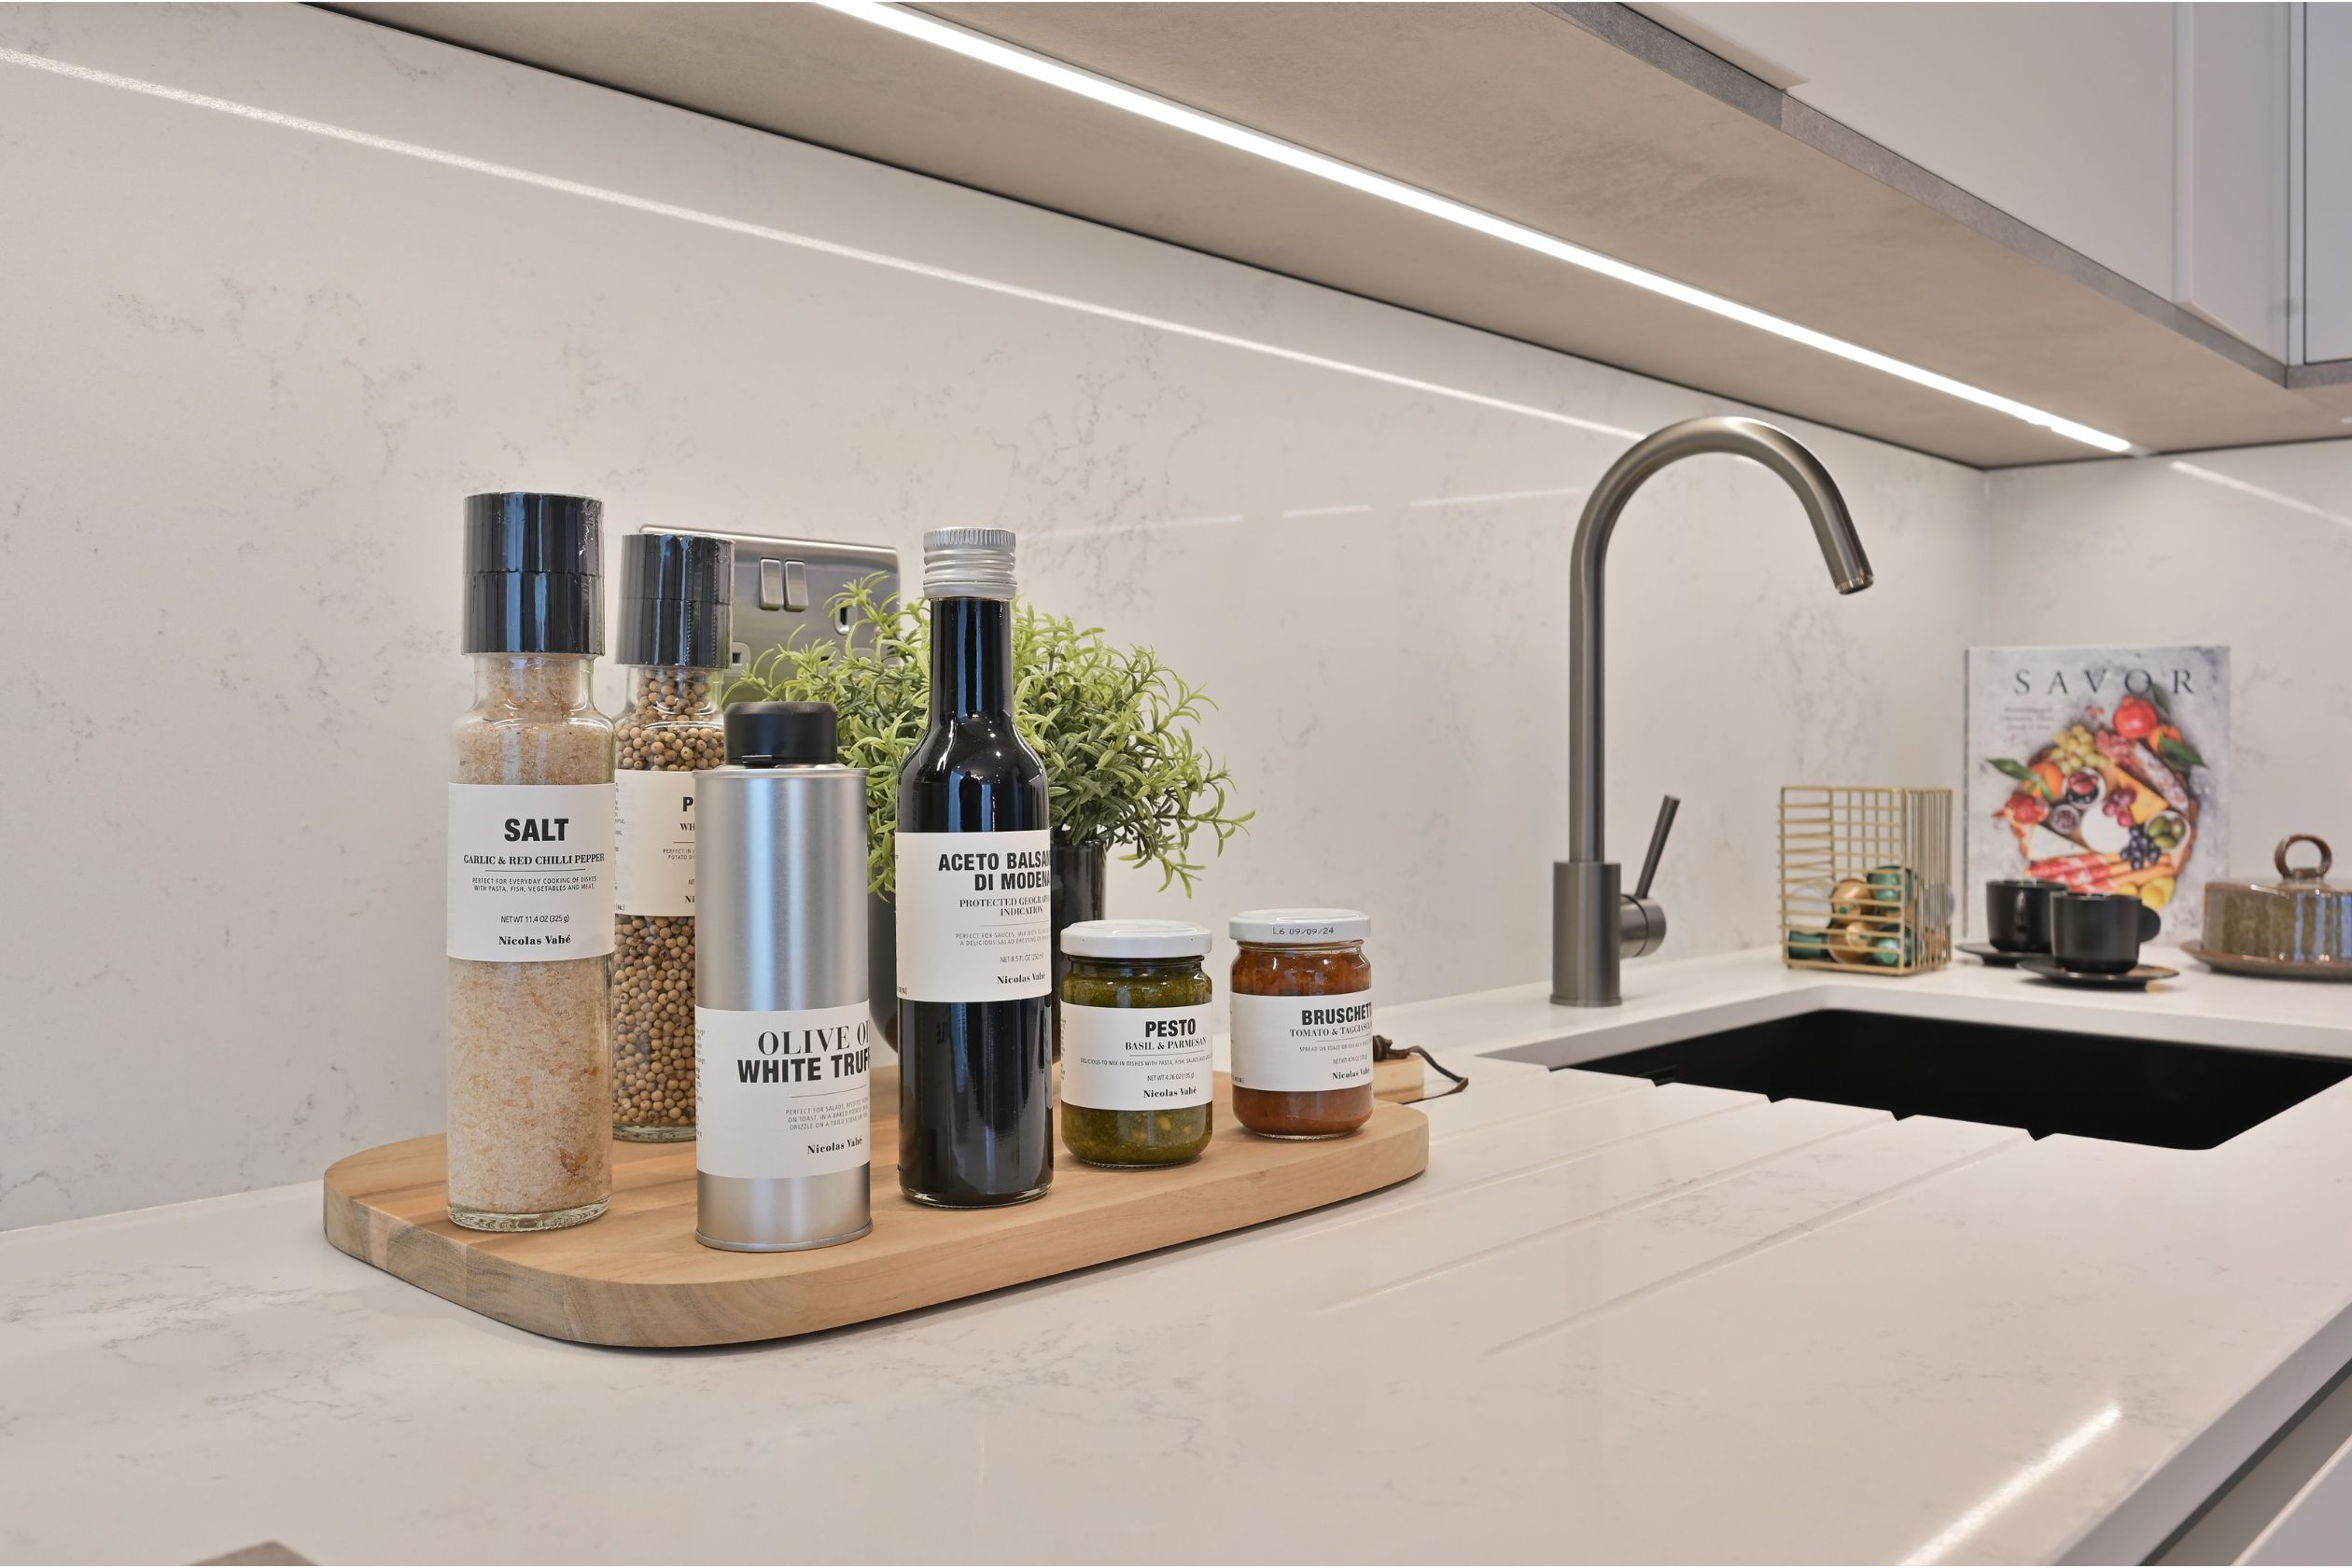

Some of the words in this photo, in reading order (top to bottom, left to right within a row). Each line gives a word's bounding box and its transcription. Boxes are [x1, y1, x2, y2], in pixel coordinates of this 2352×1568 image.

[2014, 669, 2194, 696] SAVOR
[504, 818, 569, 842] SALT
[463, 854, 496, 864] GARLIC
[497, 855, 506, 864] &
[509, 856, 533, 864] RED
[535, 855, 572, 864] CHILLI
[575, 853, 605, 863] PEPPER
[938, 852, 1000, 872] ACETO
[974, 874, 993, 891] DI
[959, 897, 1017, 907] PROTECTED
[1001, 905, 1043, 917] INDICATION
[549, 915, 563, 924] (325
[564, 914, 570, 924] g)
[1289, 926, 1335, 935] 09/09/24
[498, 935, 541, 945] Nicolas
[545, 933, 571, 945] Vahé
[997, 974, 1030, 985] Nicolas
[1032, 971, 1045, 981] Vahé
[1144, 1017, 1197, 1038] PESTO
[1290, 1029, 1329, 1038] TOMATO
[758, 1025, 850, 1057] OLIVE
[1125, 1042, 1155, 1051] BASIL
[1157, 1042, 1165, 1050] &
[1167, 1037, 1208, 1049] PARMESAN
[1080, 1057, 1101, 1066] DELICIOUS
[737, 1057, 821, 1084] WHITE
[1332, 1070, 1359, 1080] Nicolas
[1143, 1088, 1178, 1098] Nicolas
[1180, 1085, 1197, 1096] Vahé
[790, 1123, 814, 1131] DRIZZLE
[806, 1142, 845, 1155] Nicolas
[847, 1135, 863, 1148] Vahé
